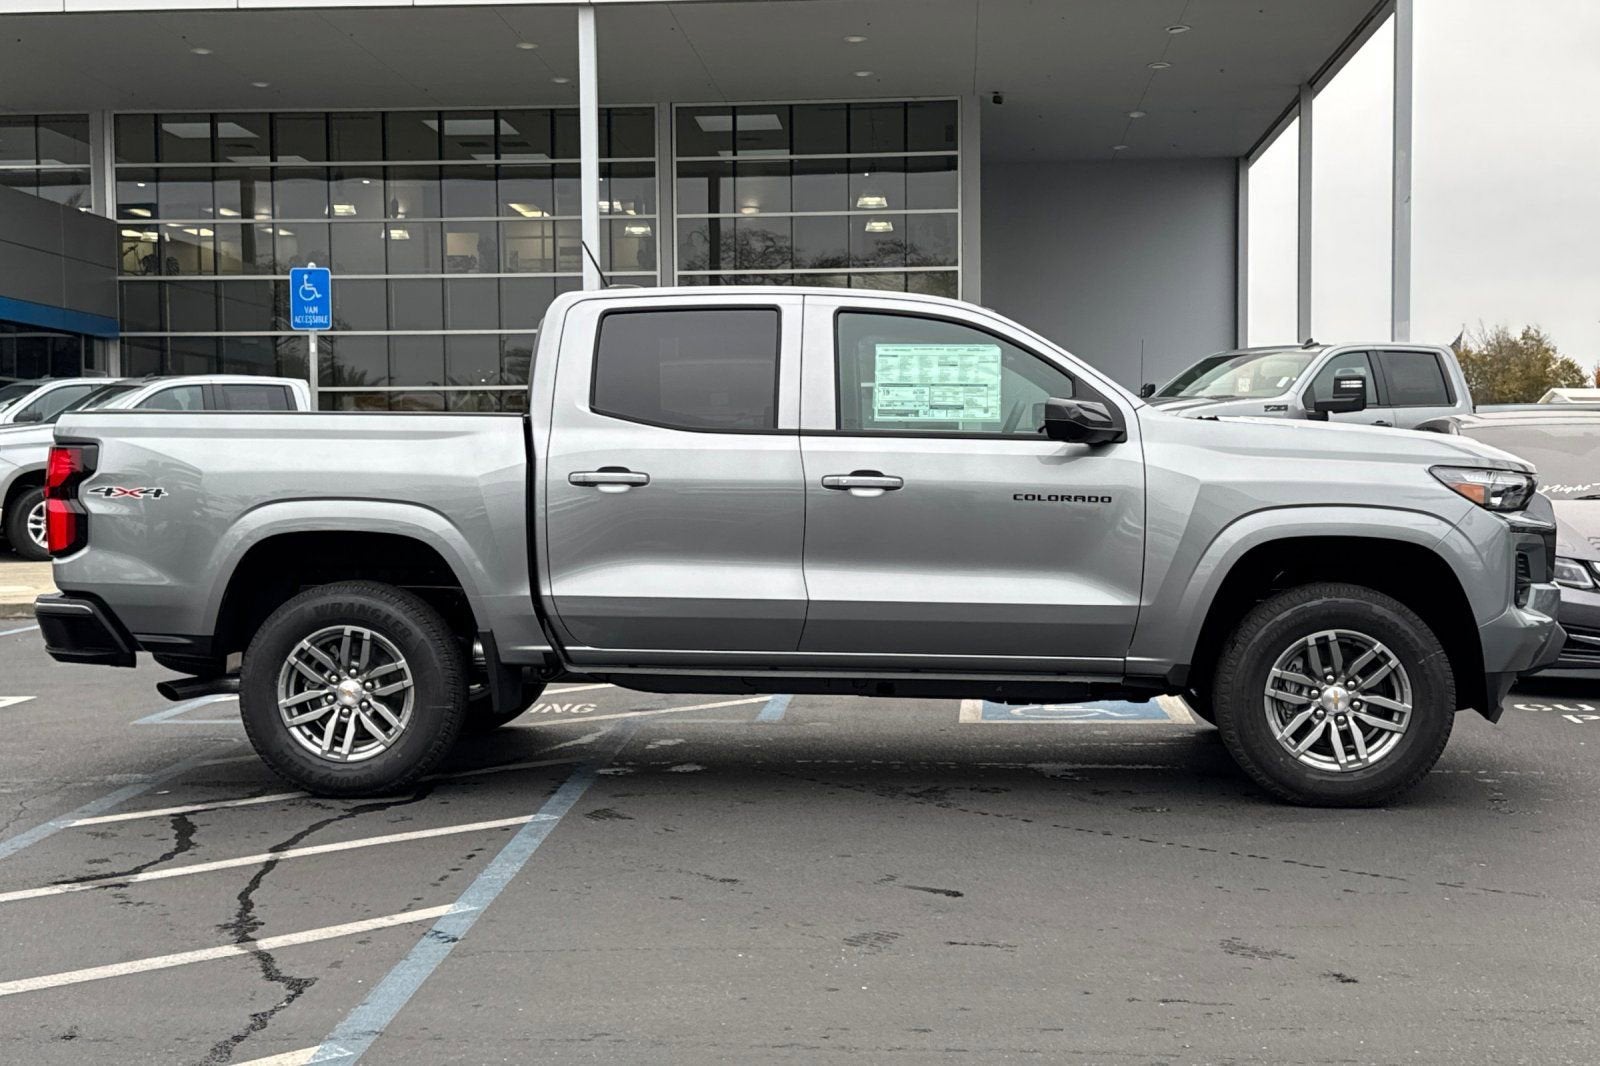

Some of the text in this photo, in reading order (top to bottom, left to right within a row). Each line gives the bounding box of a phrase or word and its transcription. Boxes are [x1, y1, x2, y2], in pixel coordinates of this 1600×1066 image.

[303, 305, 319, 314] VAN
[1012, 493, 1113, 504] COLORADO
[313, 602, 413, 637] WRANGLER
